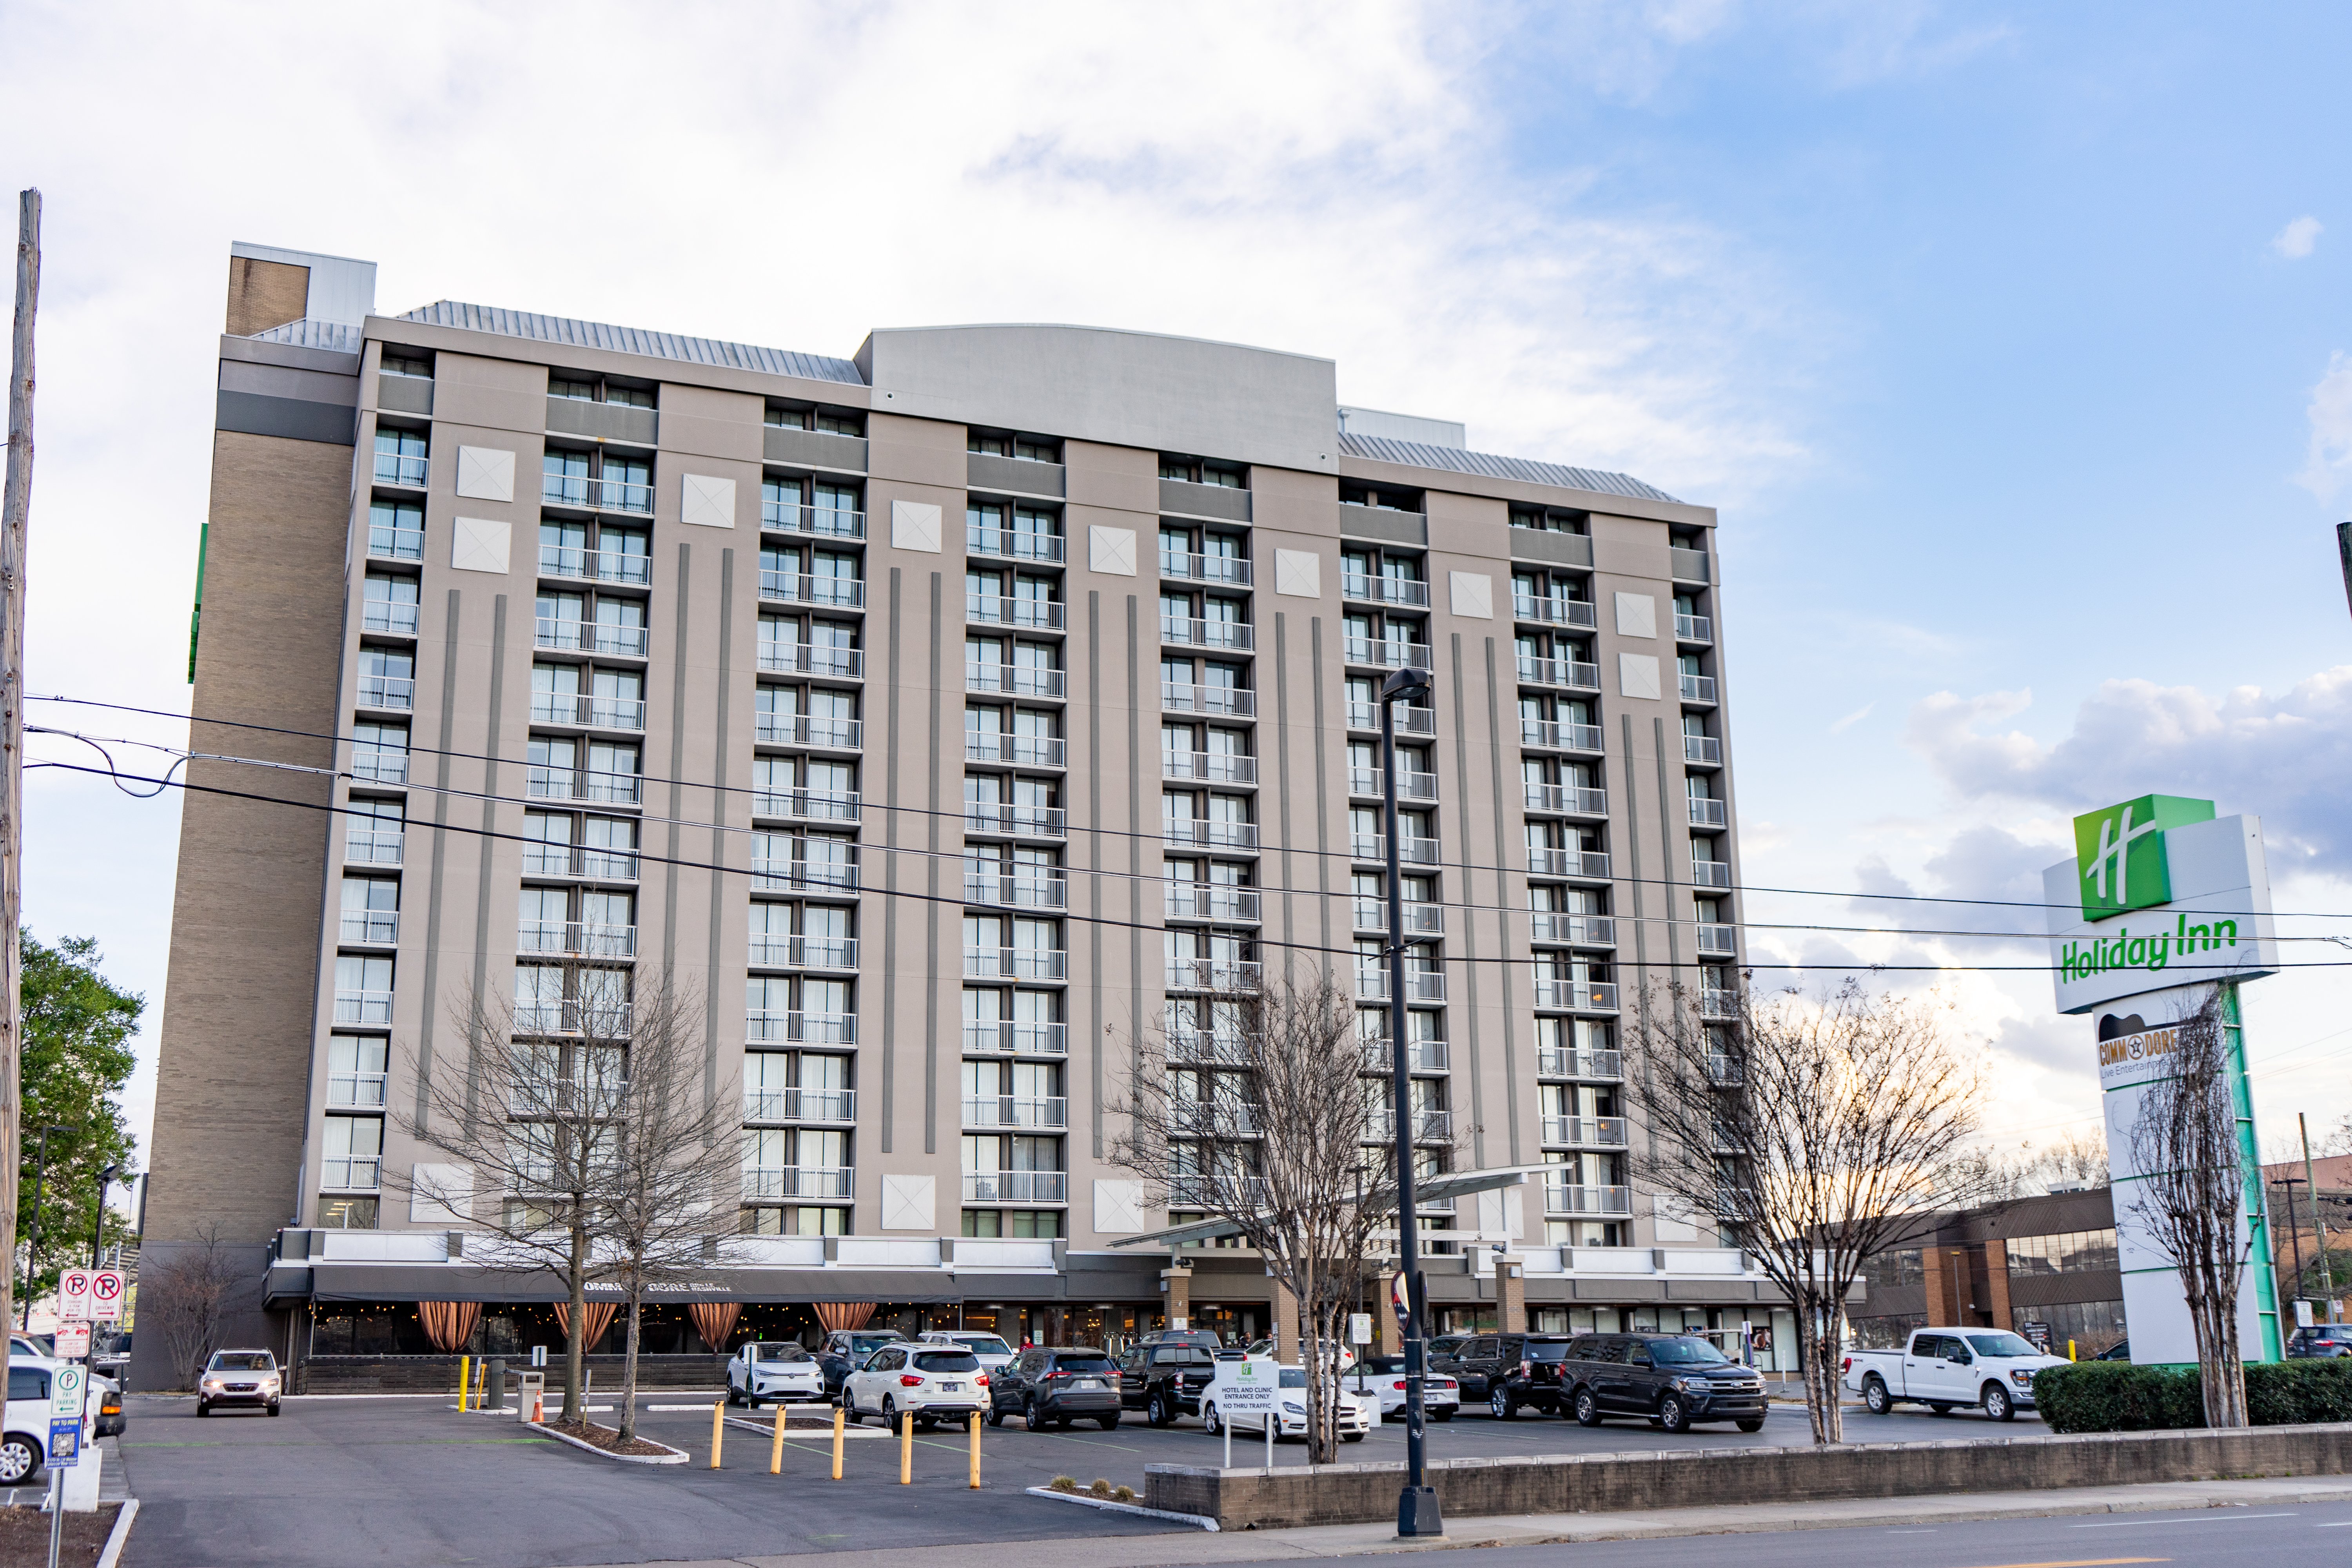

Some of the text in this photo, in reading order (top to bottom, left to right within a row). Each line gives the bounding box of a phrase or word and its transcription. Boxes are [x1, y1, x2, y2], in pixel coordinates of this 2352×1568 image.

[2061, 914, 2237, 984] Holiday Inn
[2101, 1069, 2114, 1079] Live
